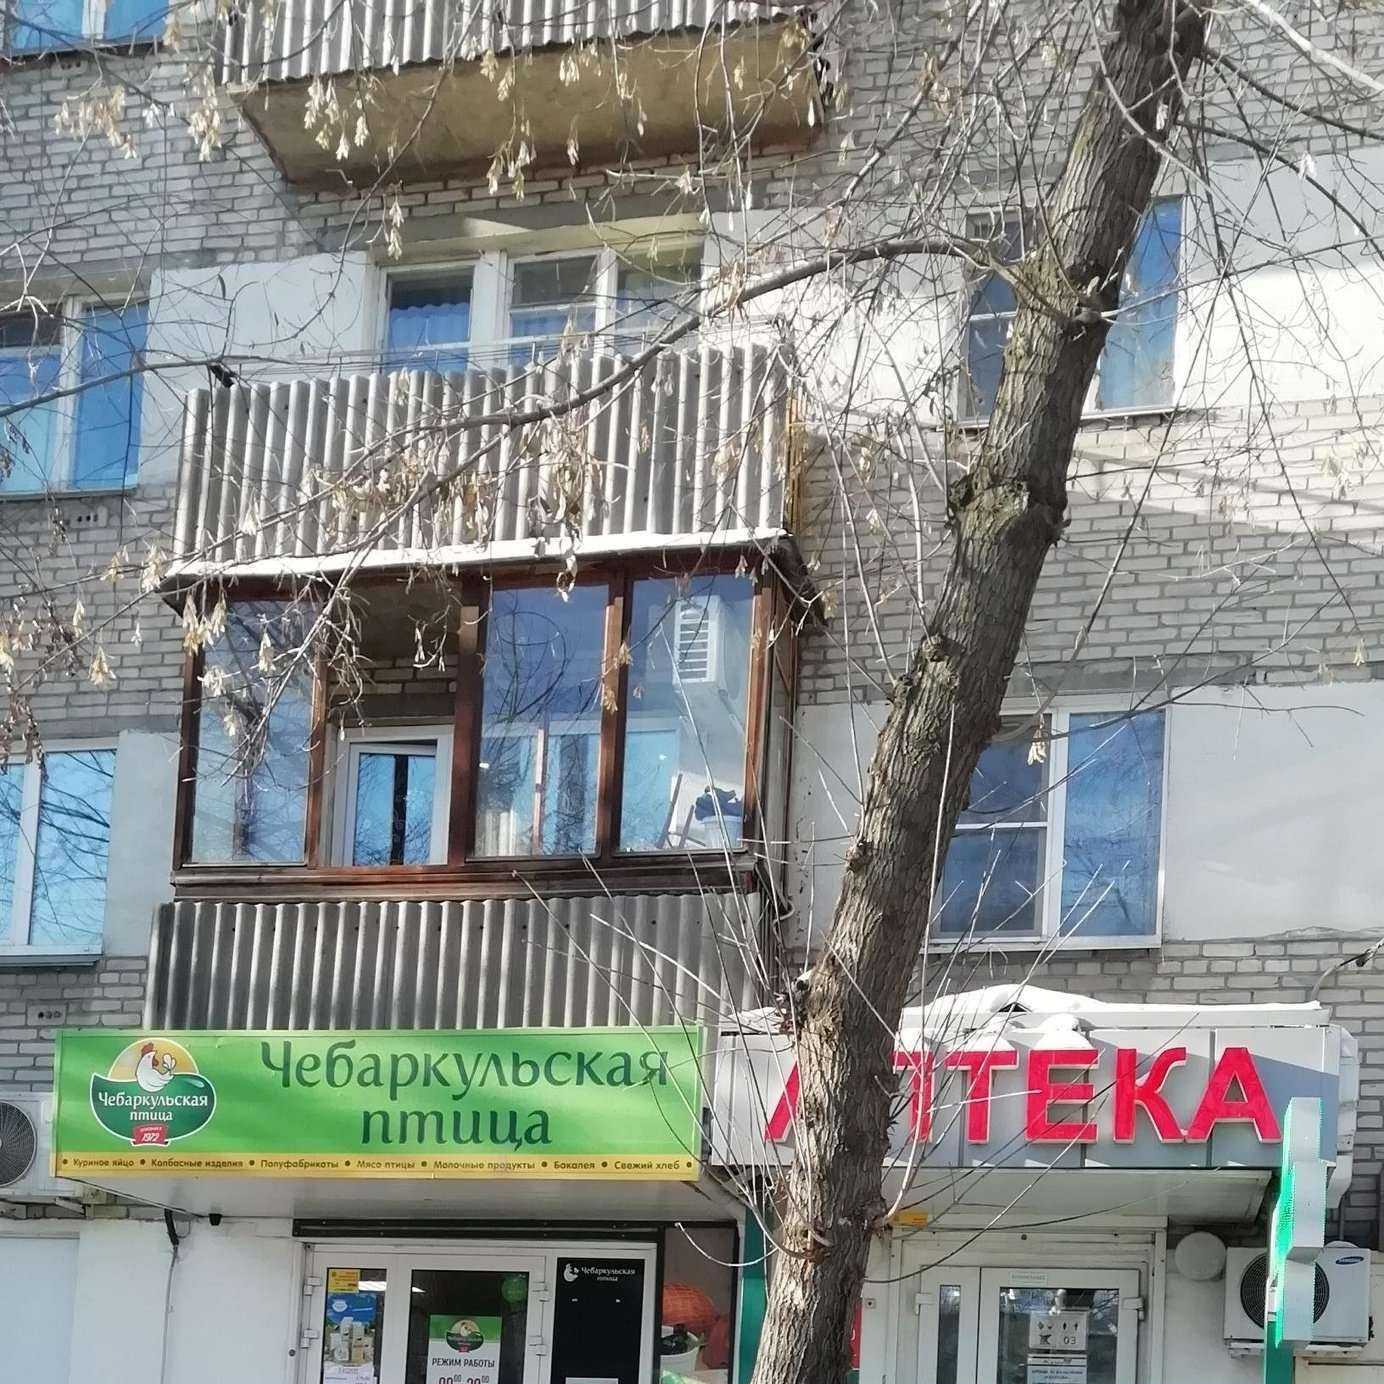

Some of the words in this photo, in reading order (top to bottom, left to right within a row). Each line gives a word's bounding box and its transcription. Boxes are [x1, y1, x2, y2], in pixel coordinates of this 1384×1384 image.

[261, 1039, 669, 1101] Чебаркульская
[98, 1092, 208, 1109] Чебаркульская
[129, 1111, 174, 1121] птица
[362, 1109, 553, 1152] птица
[73, 1158, 109, 1168] Куриное
[112, 1157, 135, 1168] яйцо
[151, 1157, 202, 1168] Колбасные
[204, 1159, 244, 1169] изделия
[260, 1158, 340, 1169] Полуфабрикаты
[356, 1160, 382, 1168] Мясо
[385, 1161, 416, 1169] птицы
[433, 1160, 485, 1169] Молочные
[488, 1162, 535, 1171] продукты
[554, 1160, 596, 1170] Бакалея
[614, 1160, 653, 1170] Свежий
[655, 1160, 681, 1170] хлеб
[432, 1357, 462, 1367] РЕЖИМ
[463, 1358, 495, 1368] РАБОТЫ
